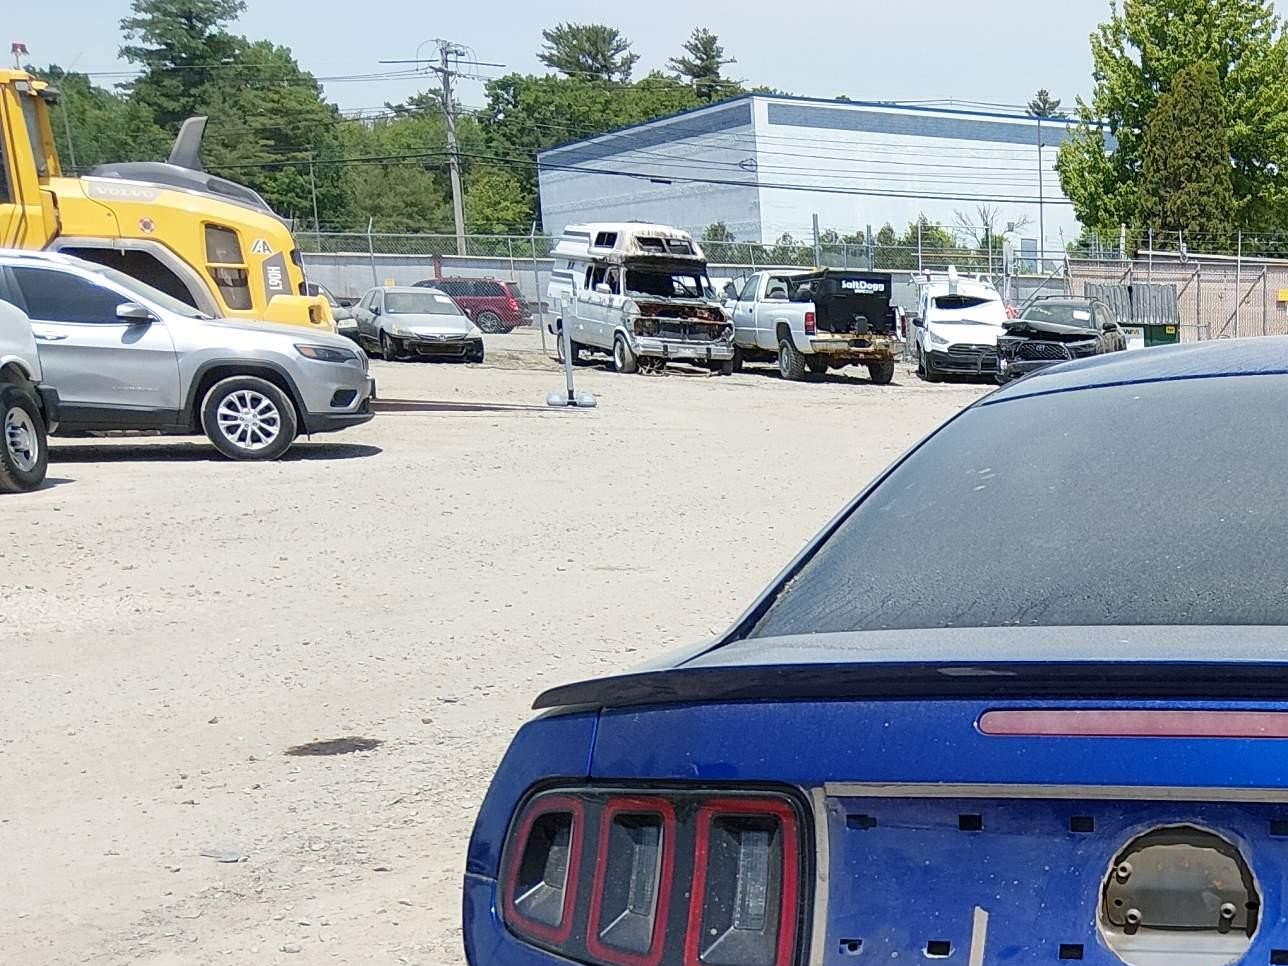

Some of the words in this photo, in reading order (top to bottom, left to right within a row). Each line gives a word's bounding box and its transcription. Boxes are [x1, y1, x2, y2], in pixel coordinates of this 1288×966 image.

[96, 187, 155, 199] VOLVO
[266, 266, 283, 290] L90H
[841, 280, 885, 292] SaltDogg
